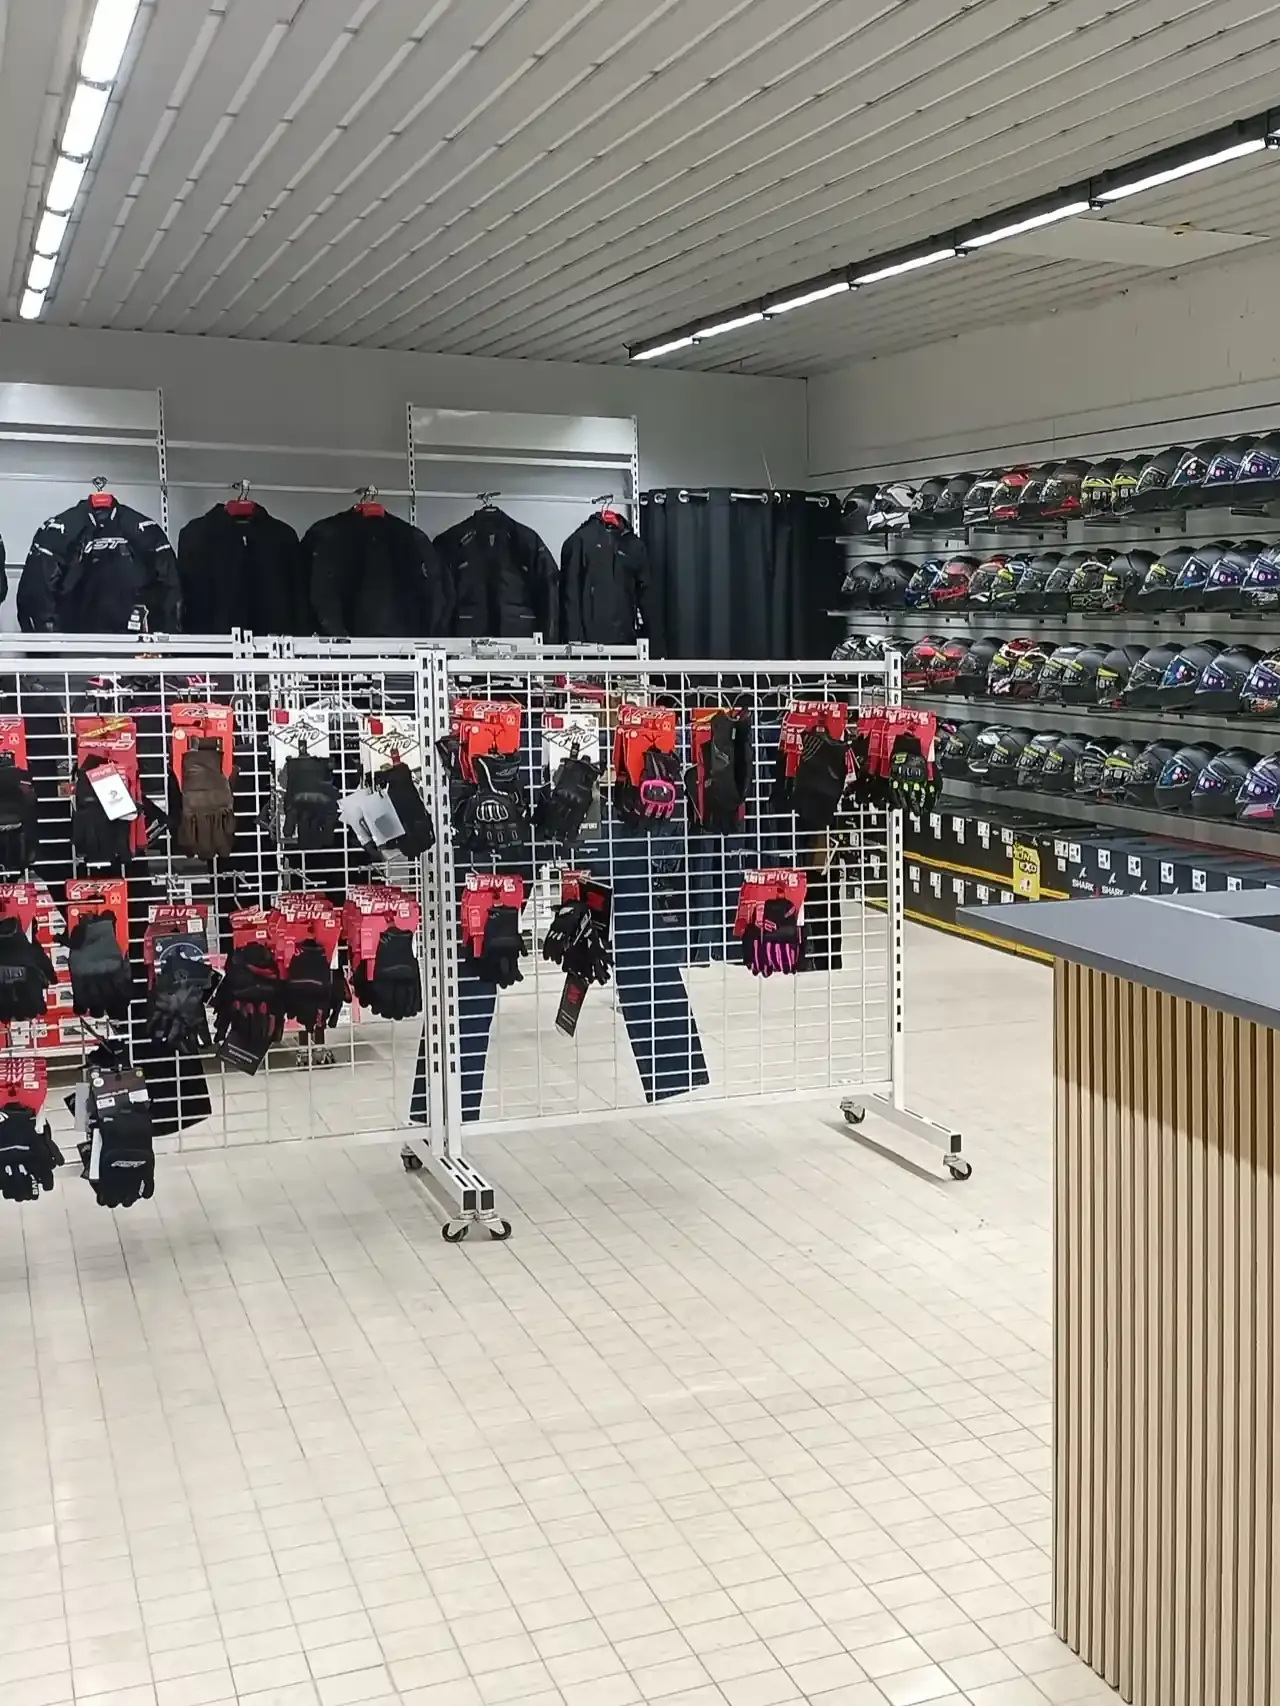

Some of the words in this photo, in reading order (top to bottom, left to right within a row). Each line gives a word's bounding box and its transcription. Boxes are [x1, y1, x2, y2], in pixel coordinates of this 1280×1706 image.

[1072, 878, 1095, 891] SHARK
[1101, 885, 1124, 895] SHARK
[374, 903, 409, 911] FIVE
[160, 908, 197, 917] FIVE
[297, 912, 332, 920] FIVE
